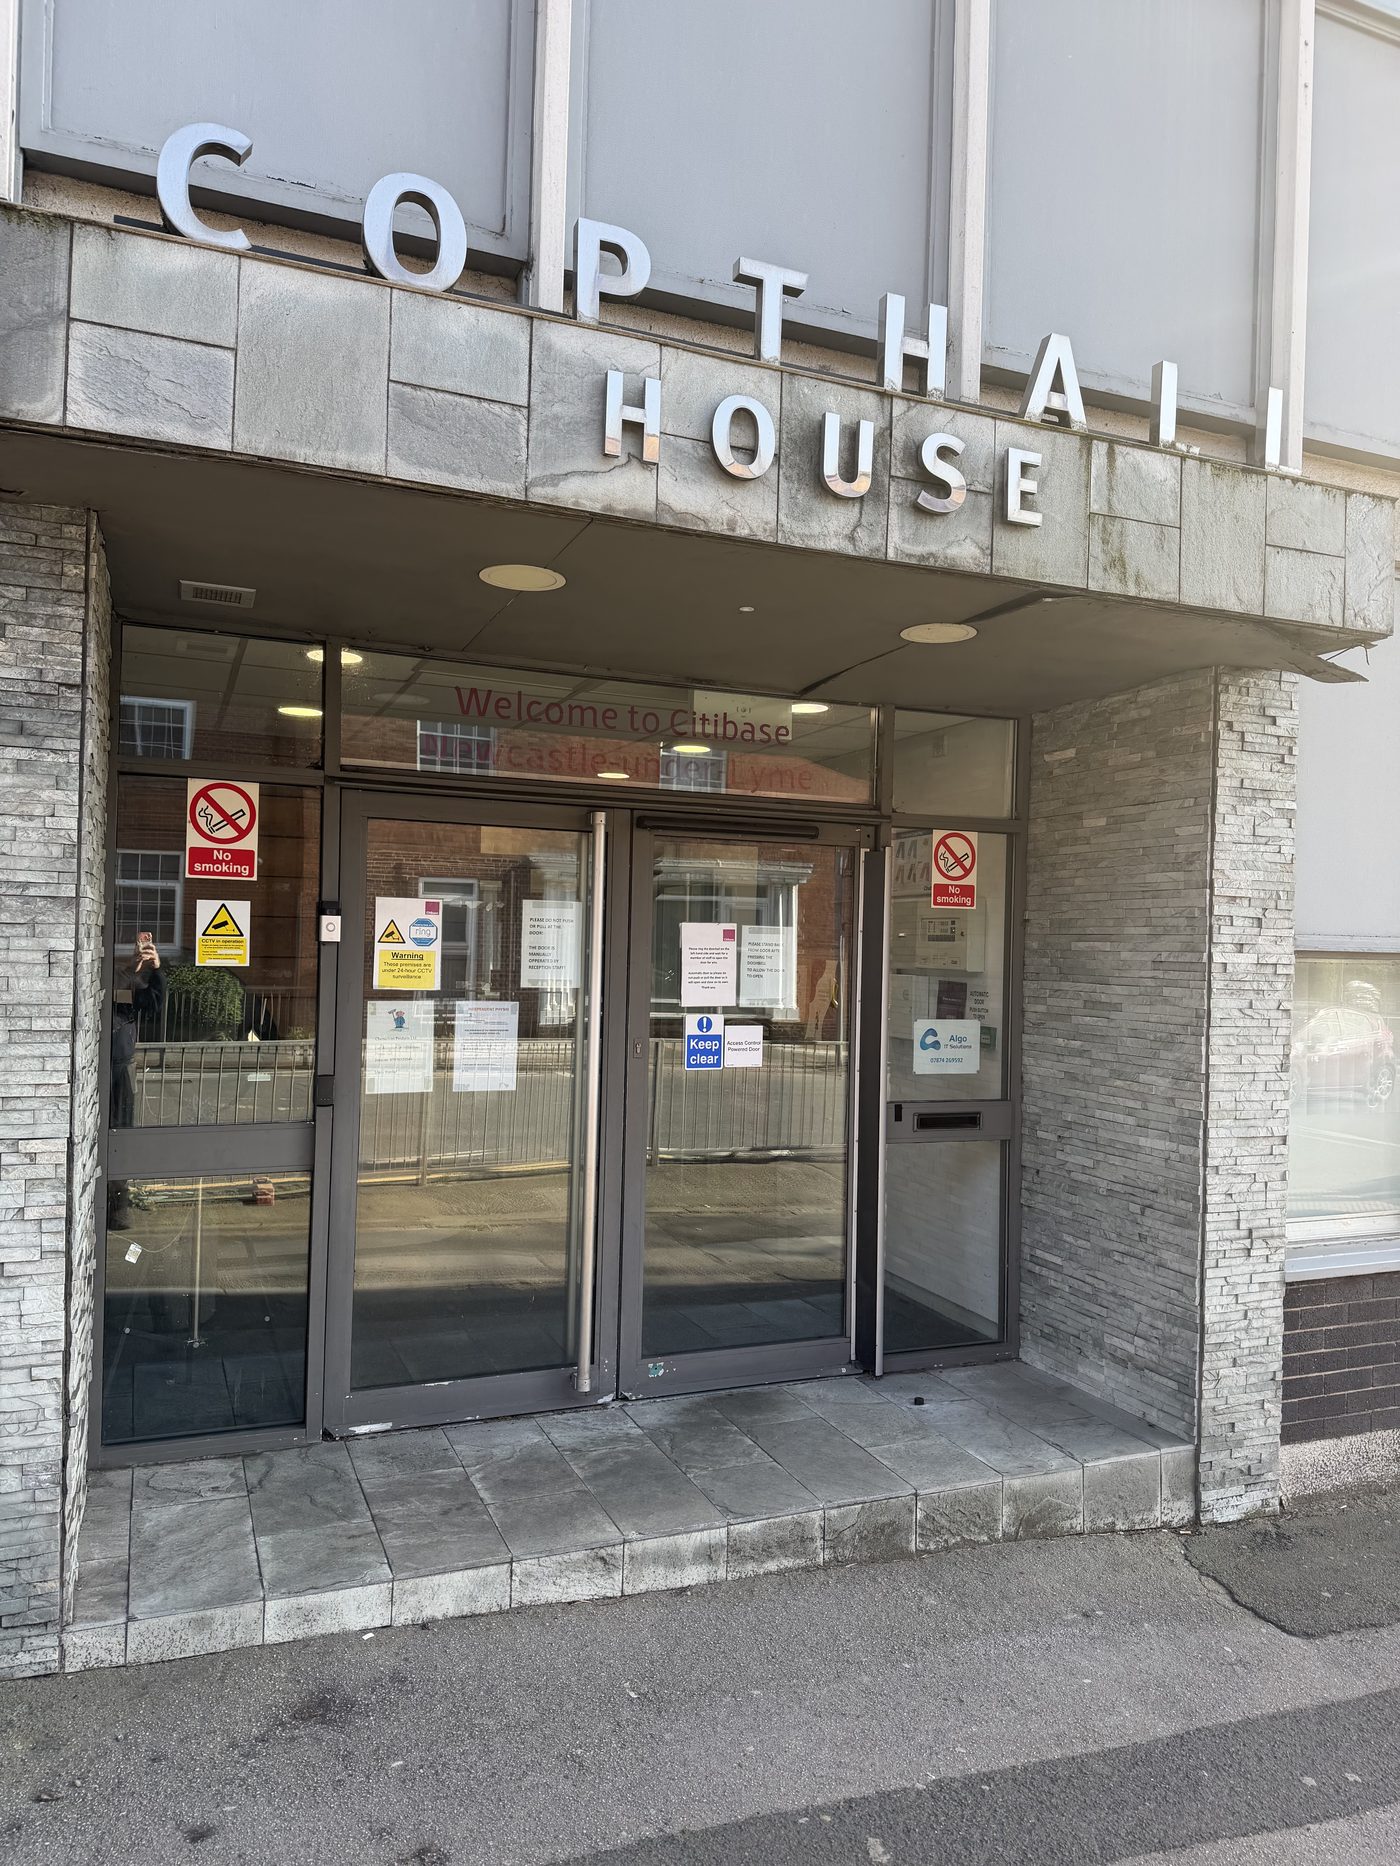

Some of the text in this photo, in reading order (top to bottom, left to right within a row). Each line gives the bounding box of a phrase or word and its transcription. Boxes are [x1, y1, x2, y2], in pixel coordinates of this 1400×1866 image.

[156, 122, 1302, 476] COPTHALL
[604, 369, 1043, 527] HOUSE
[454, 685, 790, 746] Welcome to Citibase
[213, 849, 232, 861] No
[194, 862, 249, 876] smoking
[948, 885, 961, 894] No
[937, 895, 972, 906] smoking
[416, 927, 431, 937] ring
[391, 952, 424, 960] Warning
[949, 1035, 968, 1044] Algo
[690, 1039, 720, 1052] Keep
[690, 1053, 719, 1064] clear
